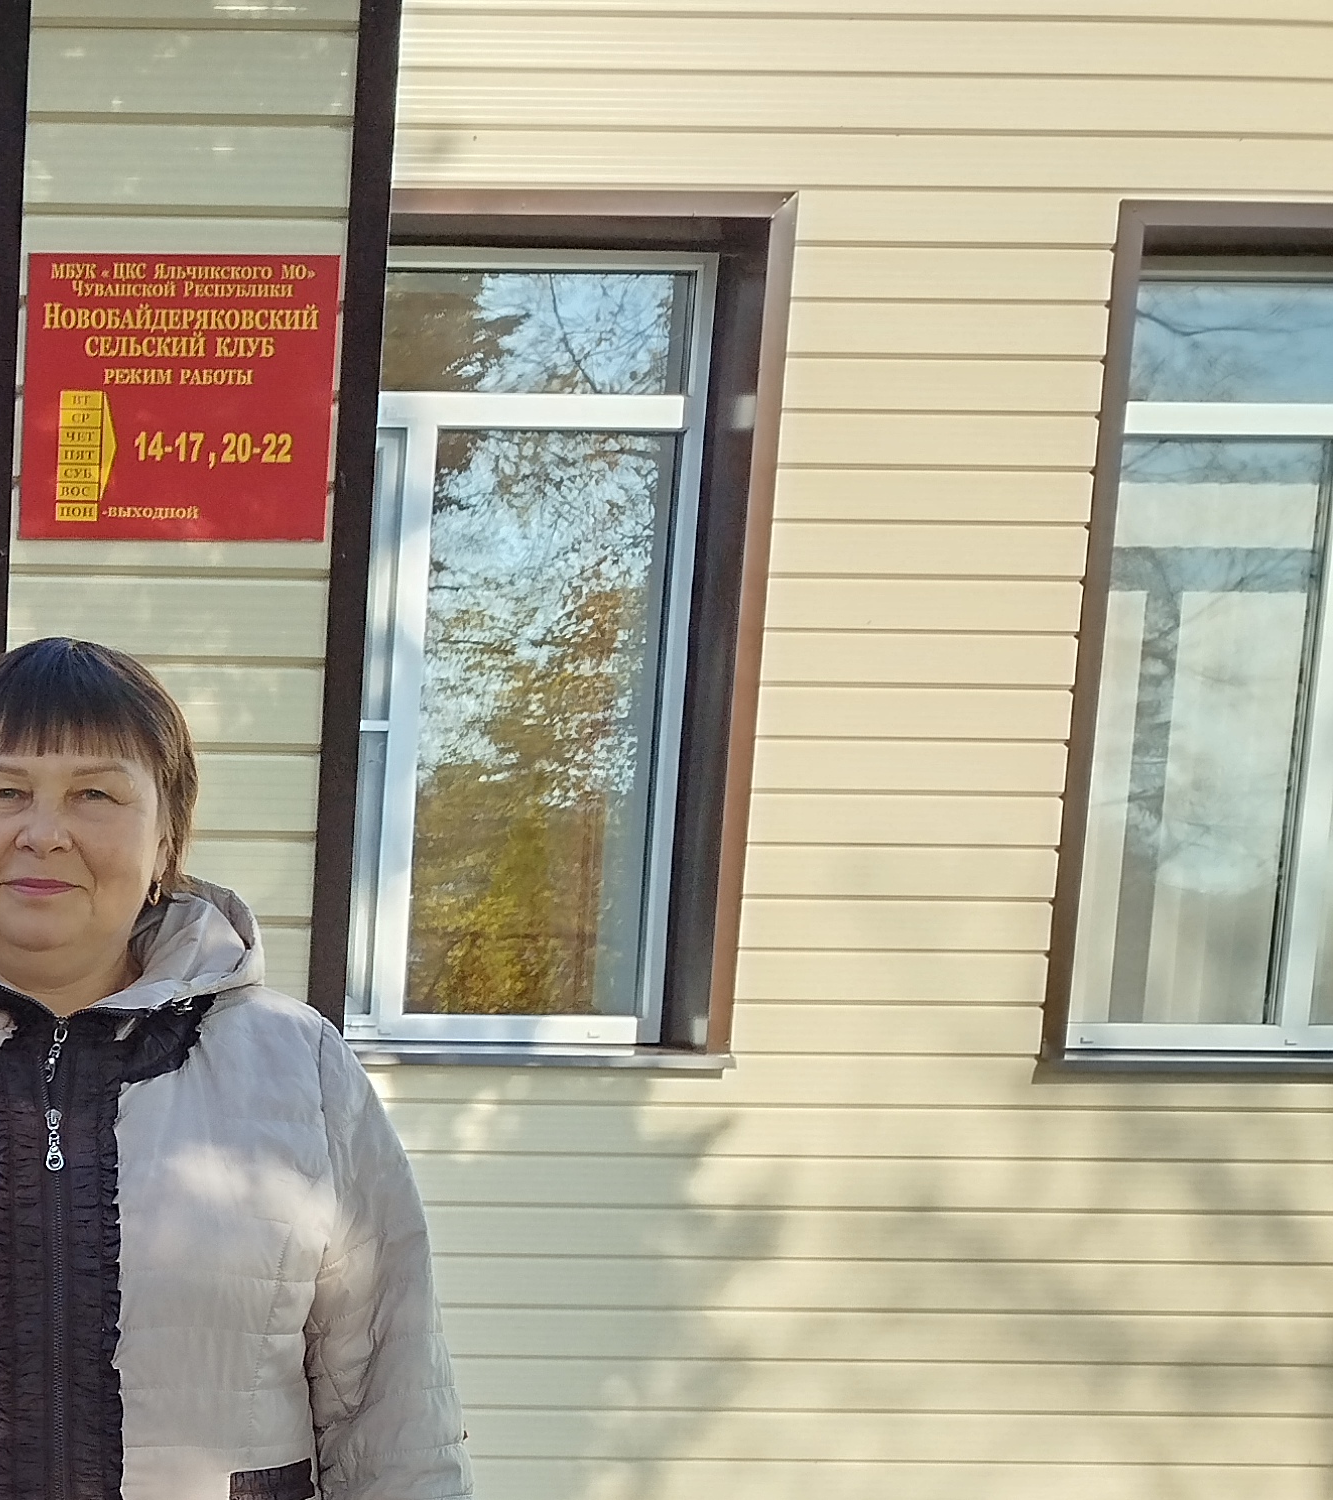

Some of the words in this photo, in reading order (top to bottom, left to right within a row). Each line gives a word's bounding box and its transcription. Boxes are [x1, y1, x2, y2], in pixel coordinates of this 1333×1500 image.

[50, 262, 97, 280] МБУК
[84, 331, 206, 357] СЕЛЬСКИЙ
[215, 337, 275, 358] КЛУБ
[103, 368, 173, 385] РЕЖИМ
[179, 368, 254, 386] РАБОТЫ
[71, 413, 90, 423] СР
[66, 431, 95, 442] ЧЕТ
[221, 433, 293, 463] 20-22
[64, 450, 95, 460] ПЯТ
[64, 468, 93, 479] СУБ
[60, 486, 91, 497] ВОС
[59, 506, 94, 517] ПОН
